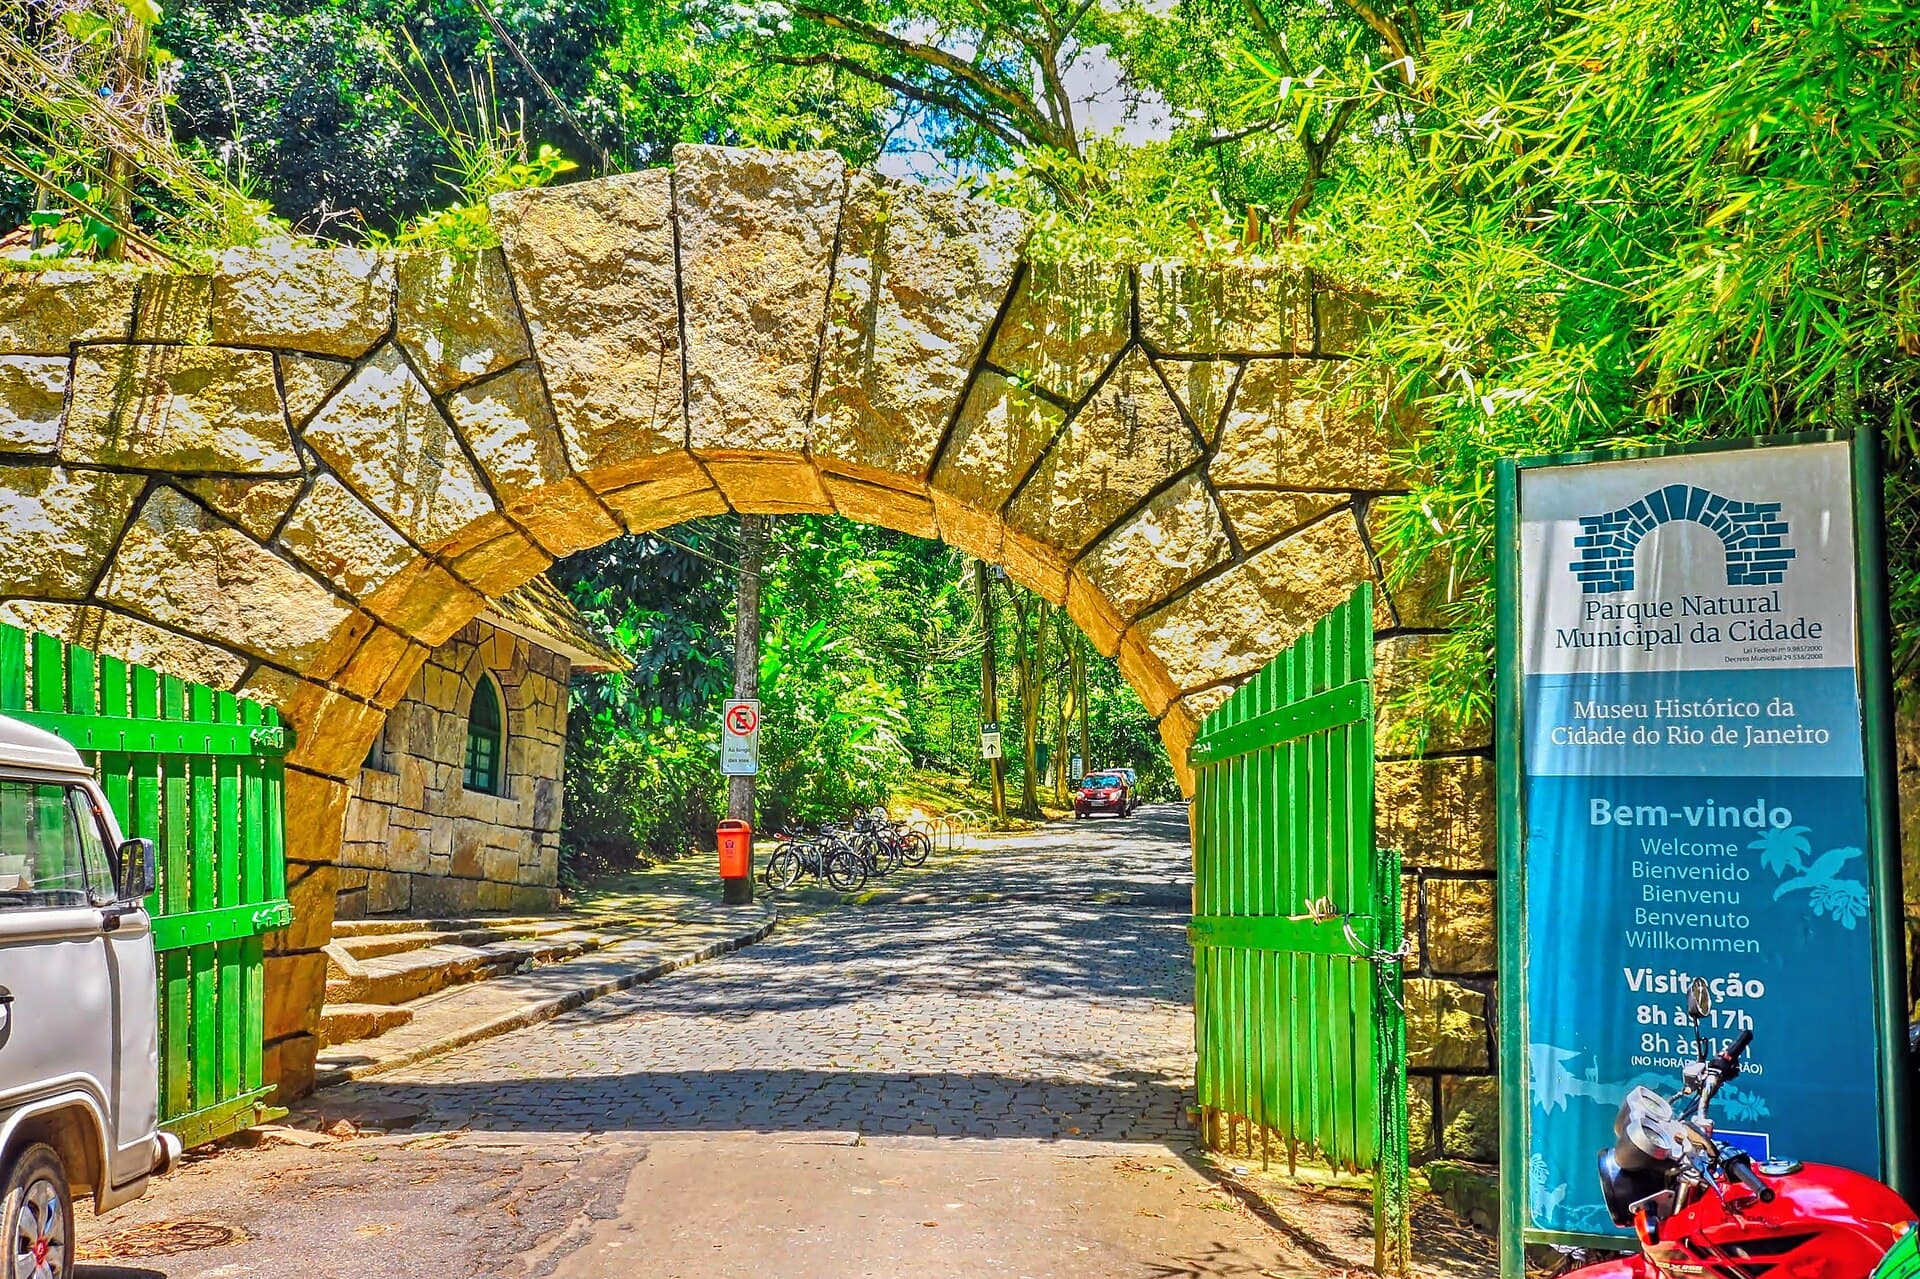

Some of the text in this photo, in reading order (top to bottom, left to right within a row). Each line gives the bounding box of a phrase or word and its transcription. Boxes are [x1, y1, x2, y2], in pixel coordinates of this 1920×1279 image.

[1585, 591, 1781, 626] Parque Natural
[1556, 618, 1823, 651] Municipal da Cidade
[1724, 655, 1750, 663] Decreto
[1750, 654, 1782, 663] Municipal
[1753, 646, 1777, 654] Federal
[1573, 696, 1796, 720] Museu Histórico da
[1551, 724, 1830, 748] Cidade do Rio de Janeiro
[1589, 797, 1793, 829] Bem-vindo
[1640, 838, 1738, 858] Welcome
[1632, 860, 1750, 882] Bienvenido
[1642, 884, 1740, 905] Bienvenu
[1634, 907, 1750, 930] Benvenuto
[1625, 930, 1760, 954] Willkommen
[1623, 967, 1765, 1003] Visitção
[1636, 1004, 1667, 1026] 8h
[1709, 1009, 1754, 1031] 17h
[1641, 1032, 1669, 1054] 8h
[1676, 1034, 1699, 1055] às
[1631, 1056, 1651, 1066] (NO
